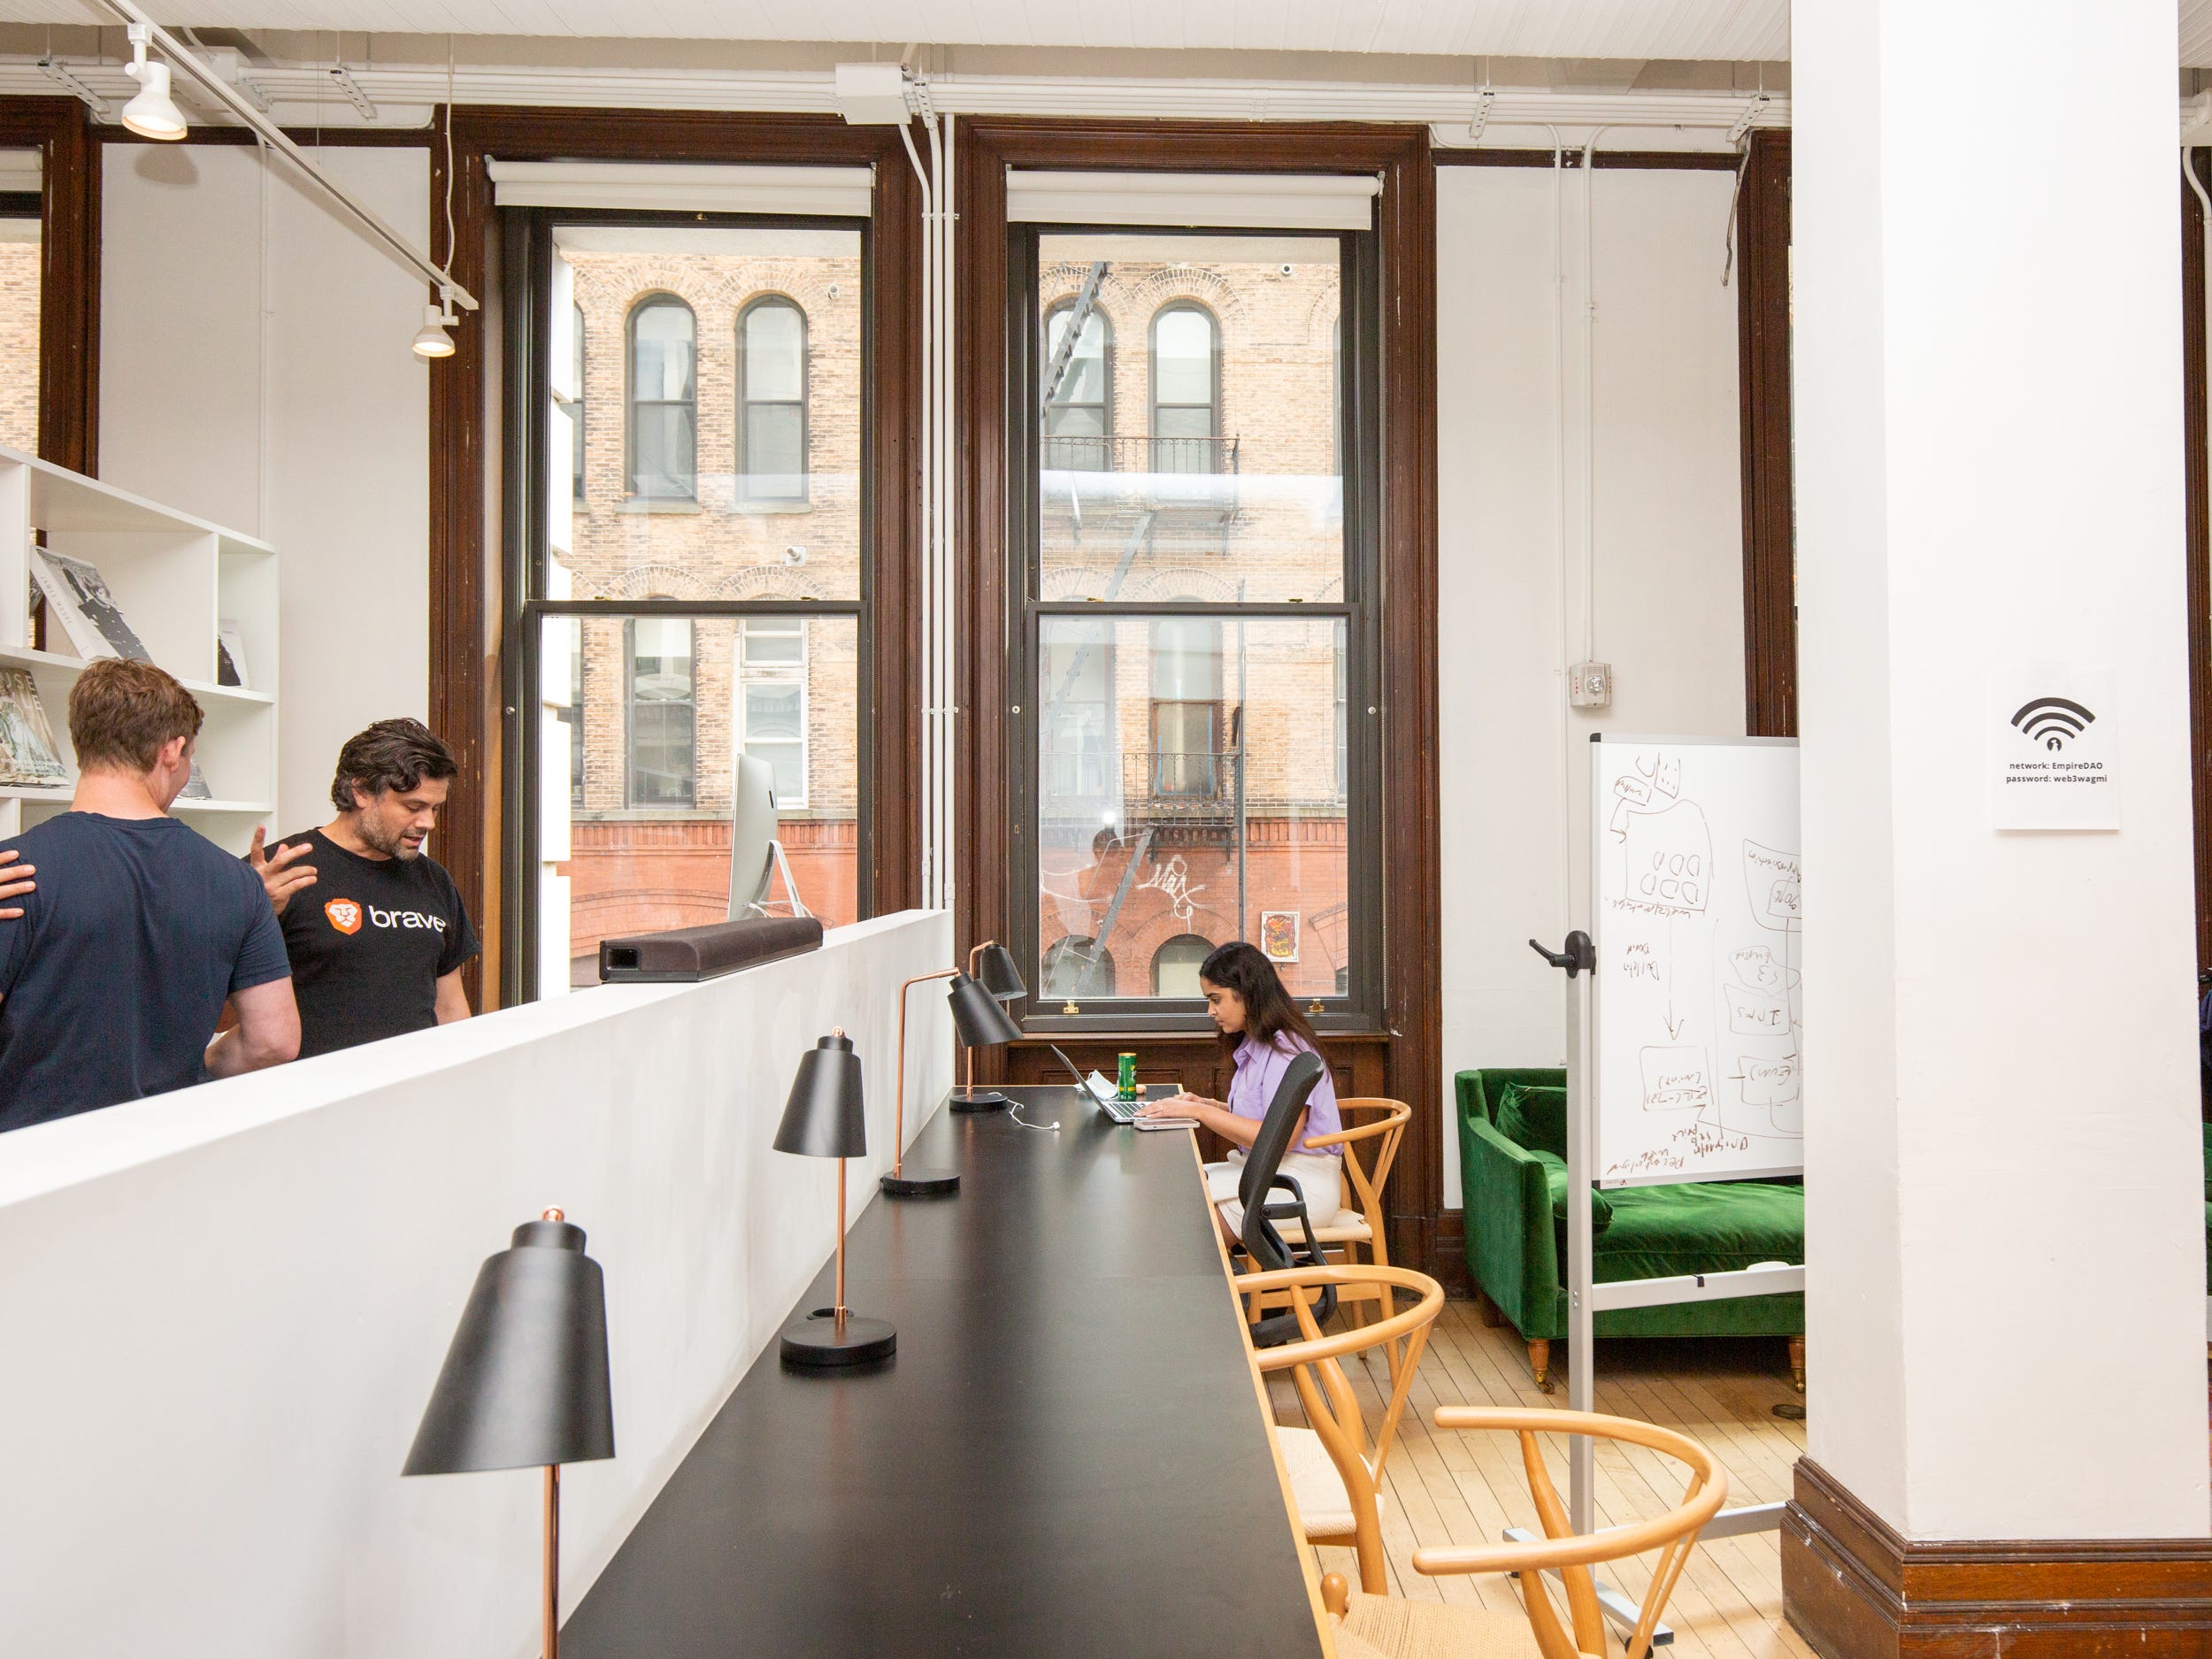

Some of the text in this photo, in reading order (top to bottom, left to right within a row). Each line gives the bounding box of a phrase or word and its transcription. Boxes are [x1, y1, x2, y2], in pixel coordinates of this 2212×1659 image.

[2052, 762, 2103, 772] EmpireDAO
[2006, 775, 2108, 784] password: web3wagmi
[368, 905, 447, 933] brave
